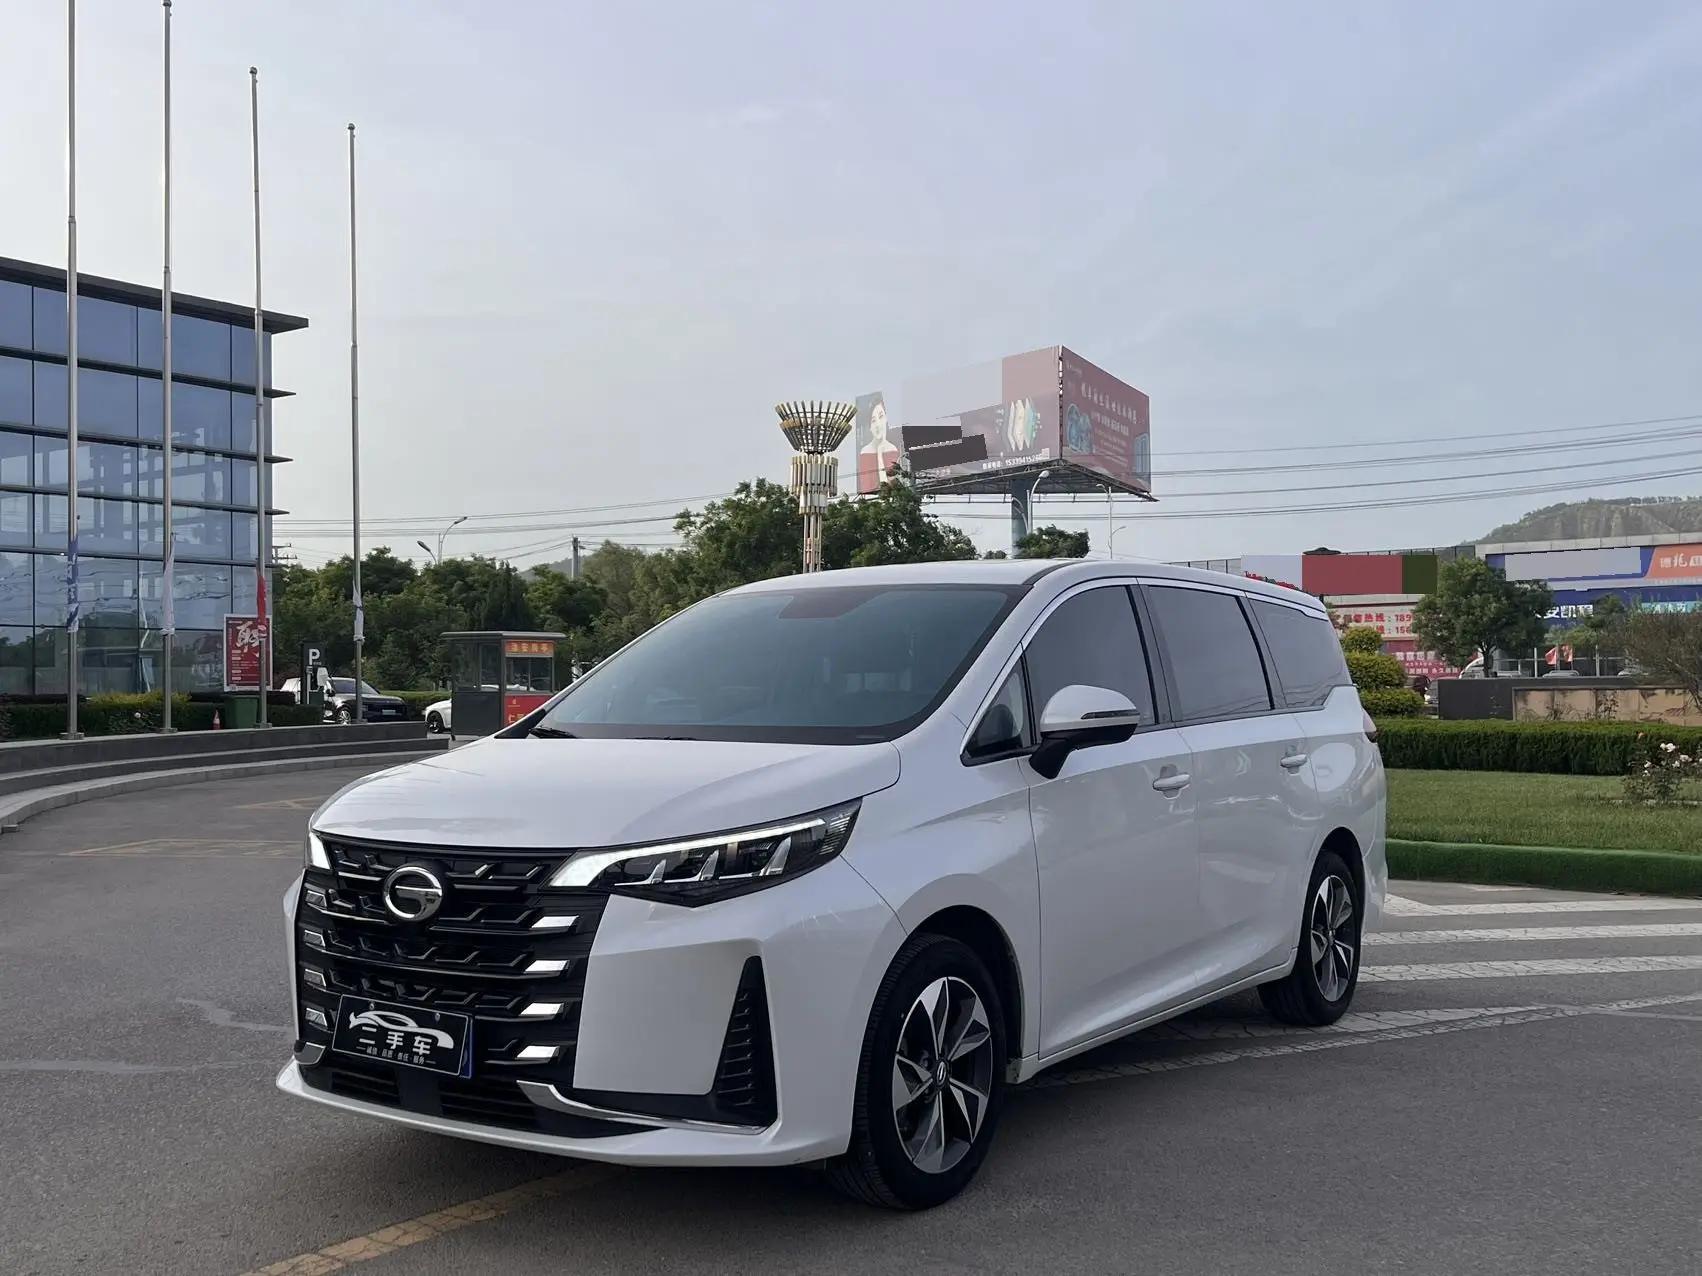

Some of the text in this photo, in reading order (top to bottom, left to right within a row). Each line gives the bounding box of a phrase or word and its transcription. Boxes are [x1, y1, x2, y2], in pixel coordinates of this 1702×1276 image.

[1530, 604, 1594, 619] 安凯程
[308, 649, 320, 665] P
[359, 1026, 432, 1055] 二手车
